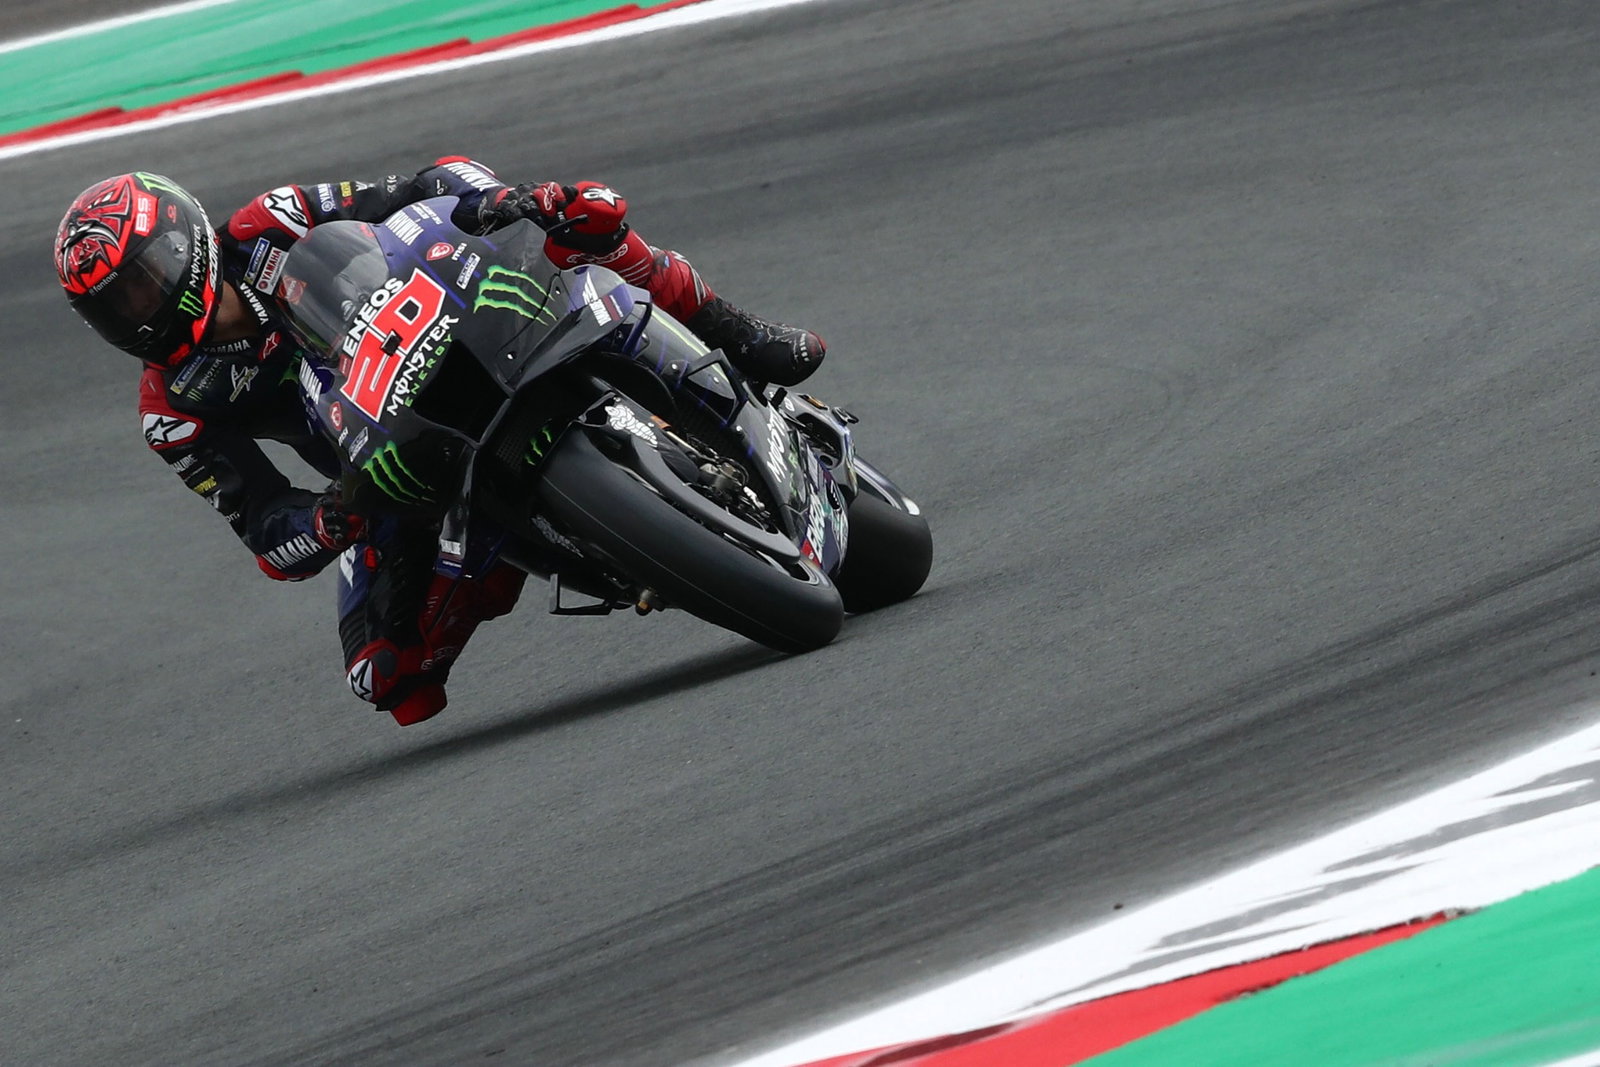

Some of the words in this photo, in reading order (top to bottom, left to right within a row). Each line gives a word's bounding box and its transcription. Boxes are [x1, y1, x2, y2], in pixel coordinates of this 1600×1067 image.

[134, 196, 150, 233] BS
[262, 248, 282, 281] YAMAHA
[451, 242, 467, 261] msi
[93, 271, 119, 292] fantom
[240, 281, 269, 326] YAMAHA
[343, 278, 405, 357] ENEOS
[340, 268, 447, 423] 20
[386, 315, 459, 416] MONSTER
[405, 333, 453, 407] ENERGY
[264, 532, 322, 570] YAMAHA
